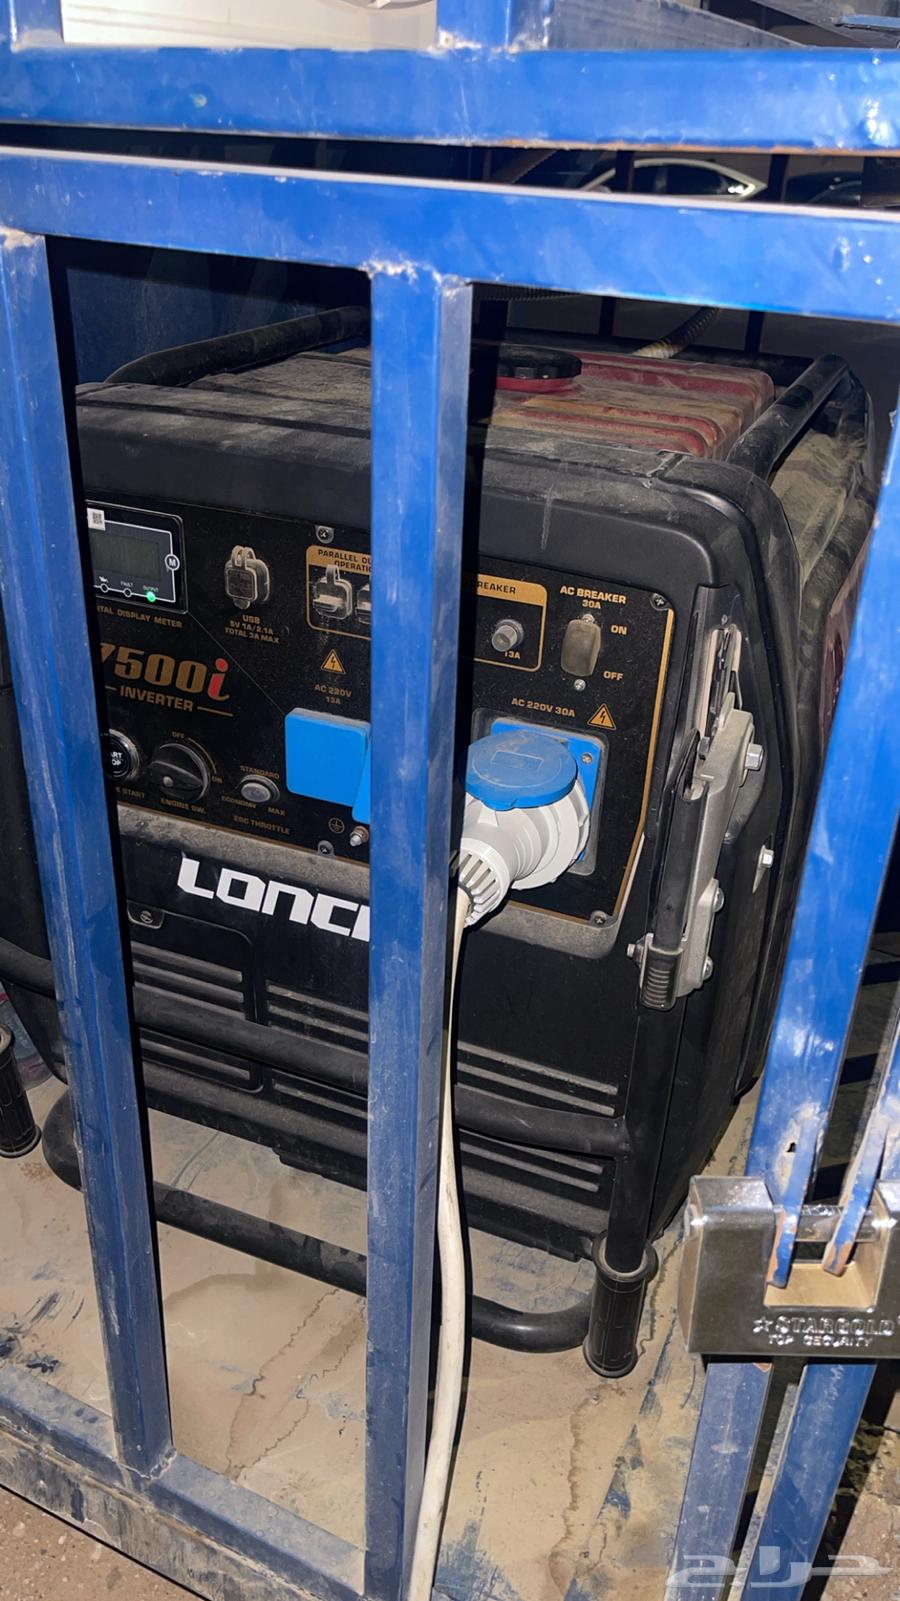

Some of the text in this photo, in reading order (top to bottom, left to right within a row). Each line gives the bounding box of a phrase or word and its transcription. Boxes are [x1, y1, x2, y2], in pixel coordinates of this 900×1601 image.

[318, 549, 358, 563] PARALLEL
[560, 585, 627, 604] AC BREAKER
[582, 599, 601, 610] 30A
[117, 608, 150, 623] DISPLAY
[154, 616, 183, 629] METER
[242, 614, 261, 625] USB
[224, 626, 247, 639] TOTAL
[260, 634, 280, 645] MAX
[611, 624, 627, 635] ON
[603, 670, 624, 681] OFF
[314, 684, 352, 698] AC 220V
[119, 685, 193, 712] INVERTER
[511, 698, 576, 717] AC 220V 30A
[240, 765, 280, 780] STANDARD
[267, 806, 286, 817] MAX
[250, 819, 290, 836] THROTTLE
[775, 1316, 895, 1336] STARGOLD
[803, 1334, 873, 1347] SECURITY
